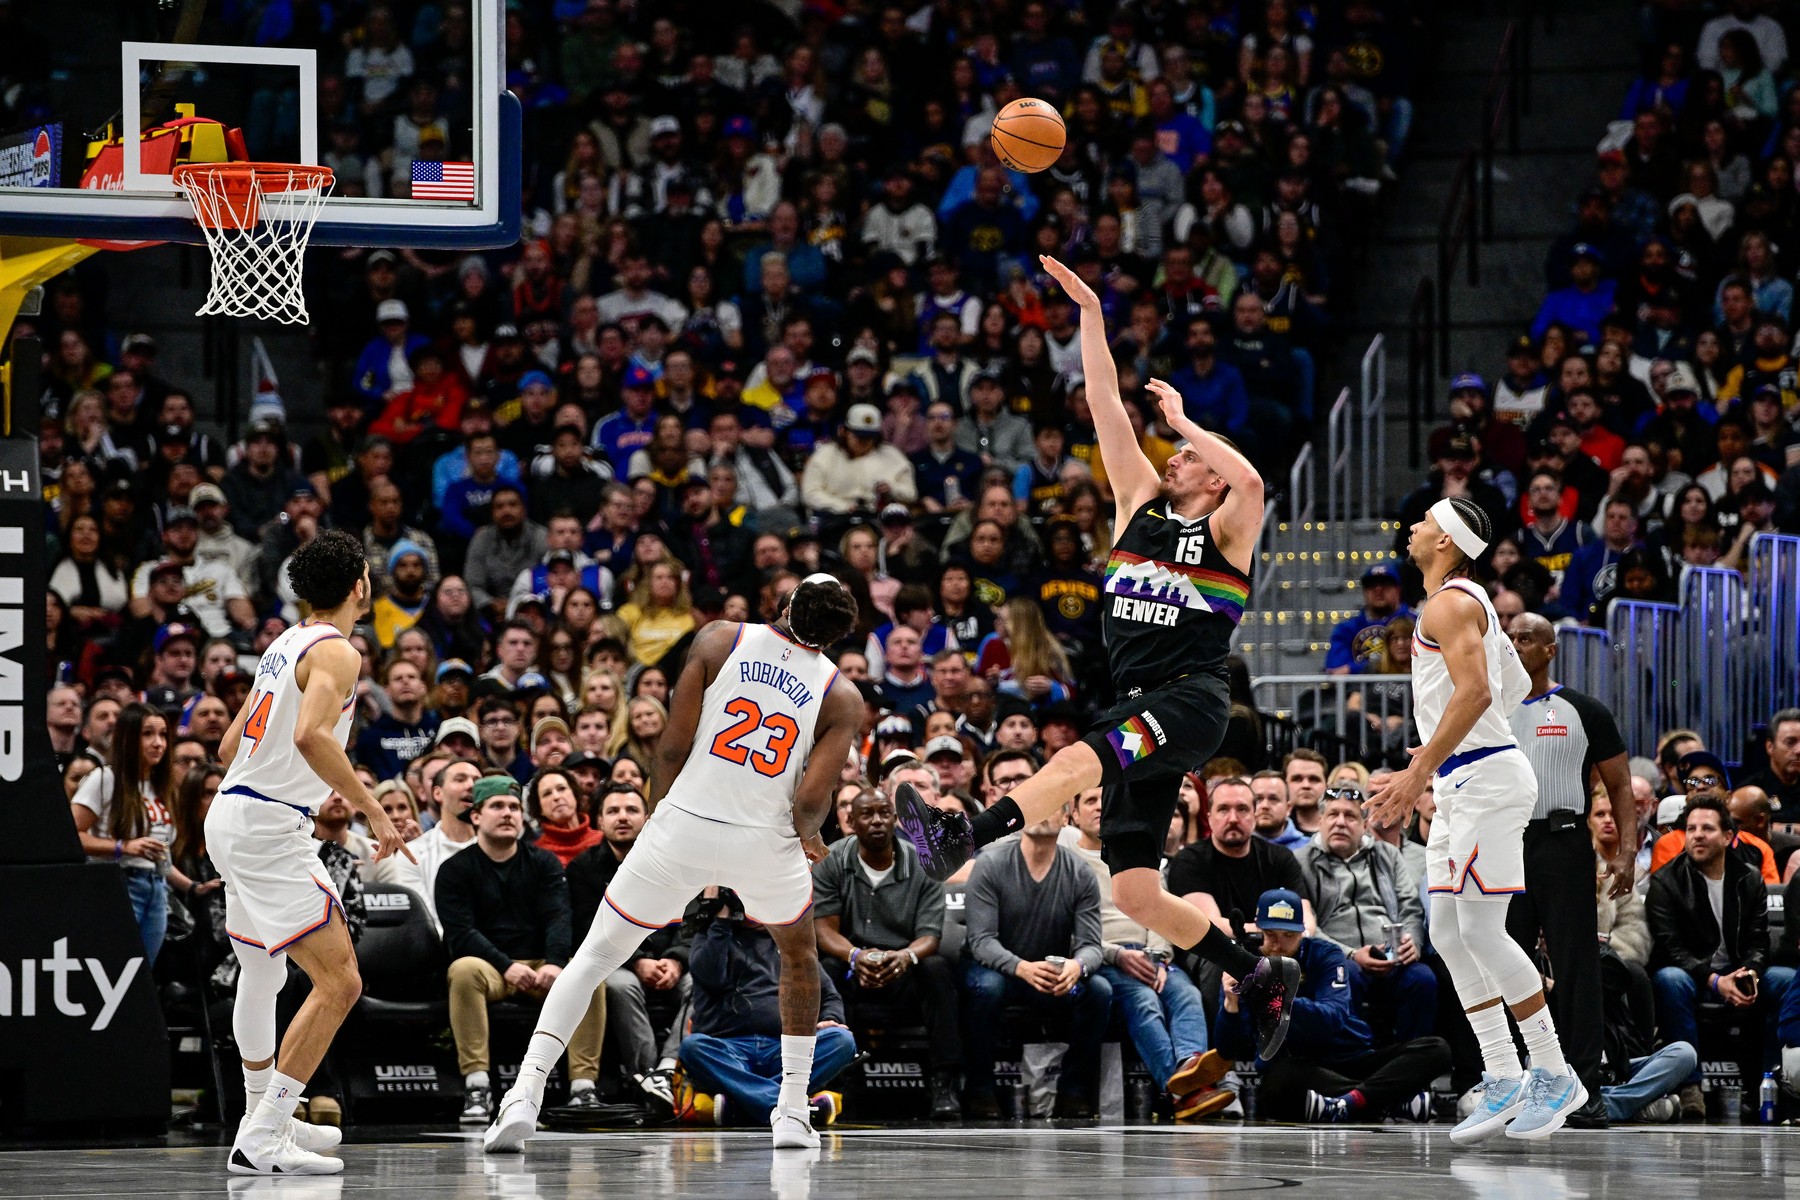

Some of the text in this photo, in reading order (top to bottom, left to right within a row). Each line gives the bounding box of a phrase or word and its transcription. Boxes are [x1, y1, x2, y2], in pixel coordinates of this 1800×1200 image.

[0, 470, 30, 492] H
[1174, 534, 1205, 565] 15
[1112, 596, 1180, 626] DENVER
[739, 660, 814, 709] ROBINSON
[709, 696, 801, 779] 23
[1140, 710, 1168, 747] NUGGETS
[1537, 727, 1567, 736] Emirates
[363, 893, 411, 907] MB
[375, 1065, 437, 1077] UMB
[863, 1062, 922, 1074] UMB
[377, 1082, 440, 1091] RESERVE
[866, 1080, 926, 1088] RESERVE
